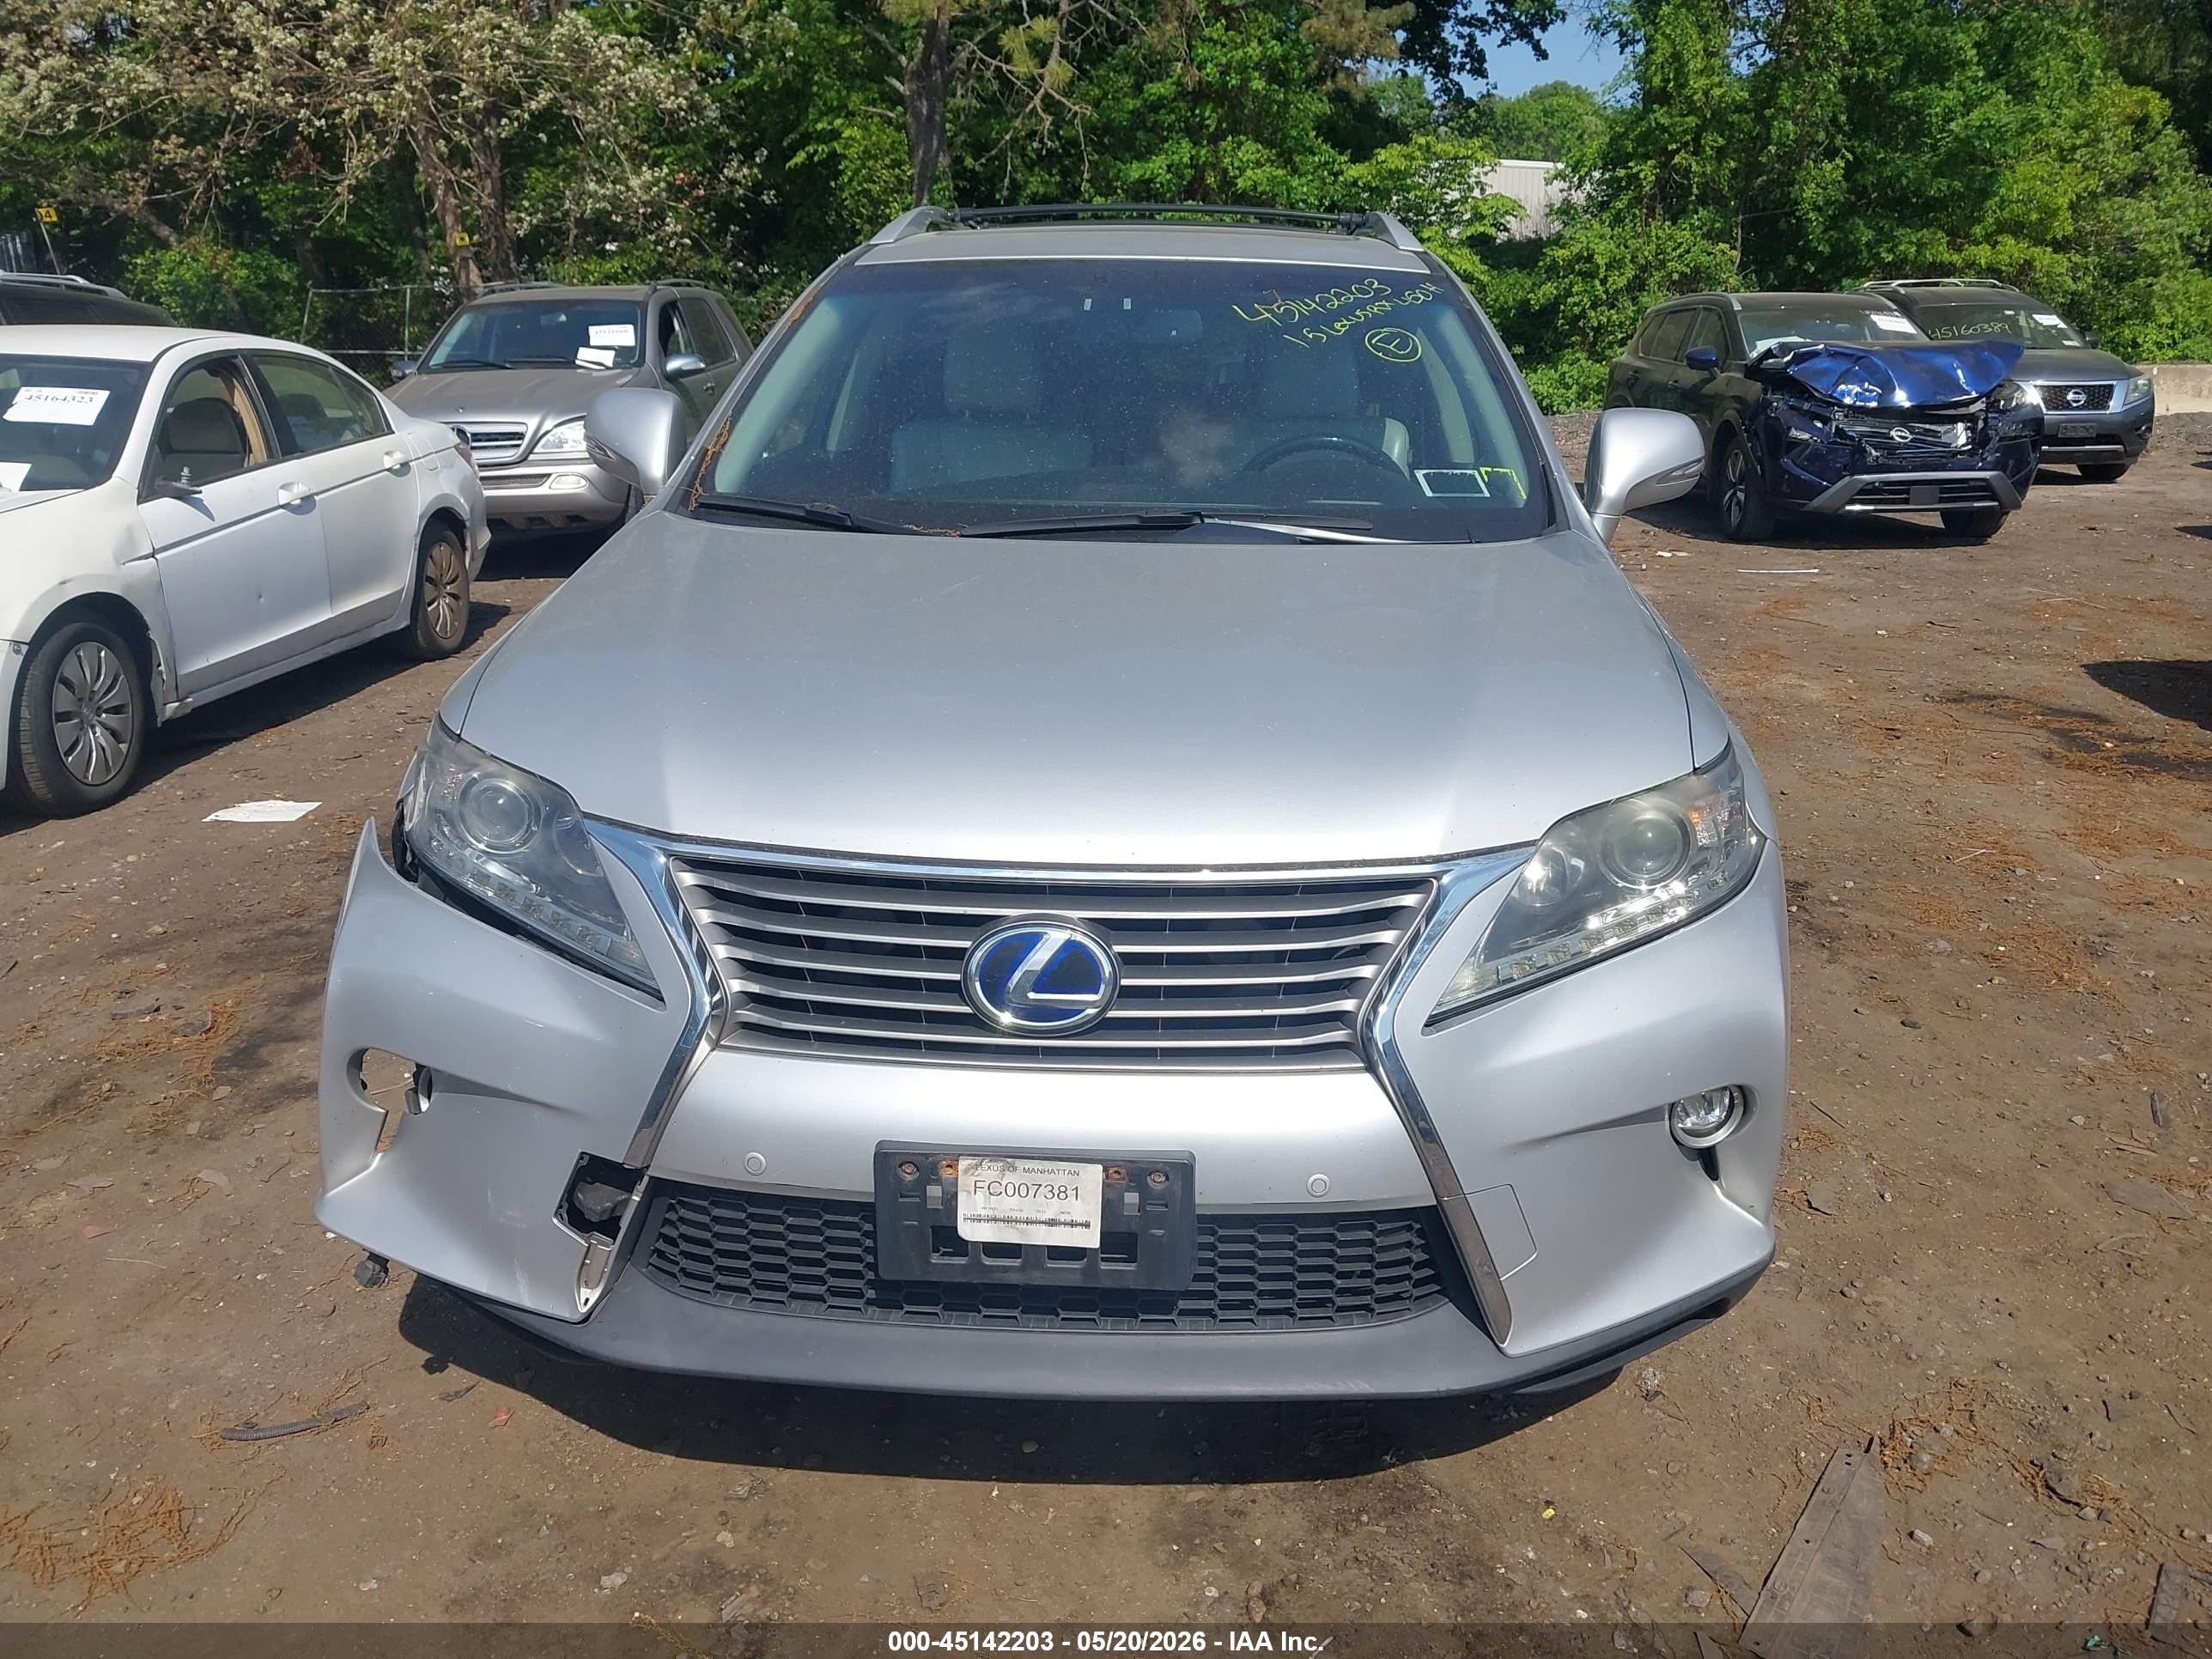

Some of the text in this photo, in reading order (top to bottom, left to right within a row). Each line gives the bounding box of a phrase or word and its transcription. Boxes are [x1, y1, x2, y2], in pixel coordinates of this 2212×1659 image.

[1232, 278, 1392, 327] 45142203
[1928, 322, 2012, 340] 45160389
[25, 394, 94, 404] 45164323
[975, 1162, 1080, 1177] LEXUS OF MANHATTAN
[973, 1179, 1079, 1201] FC007381
